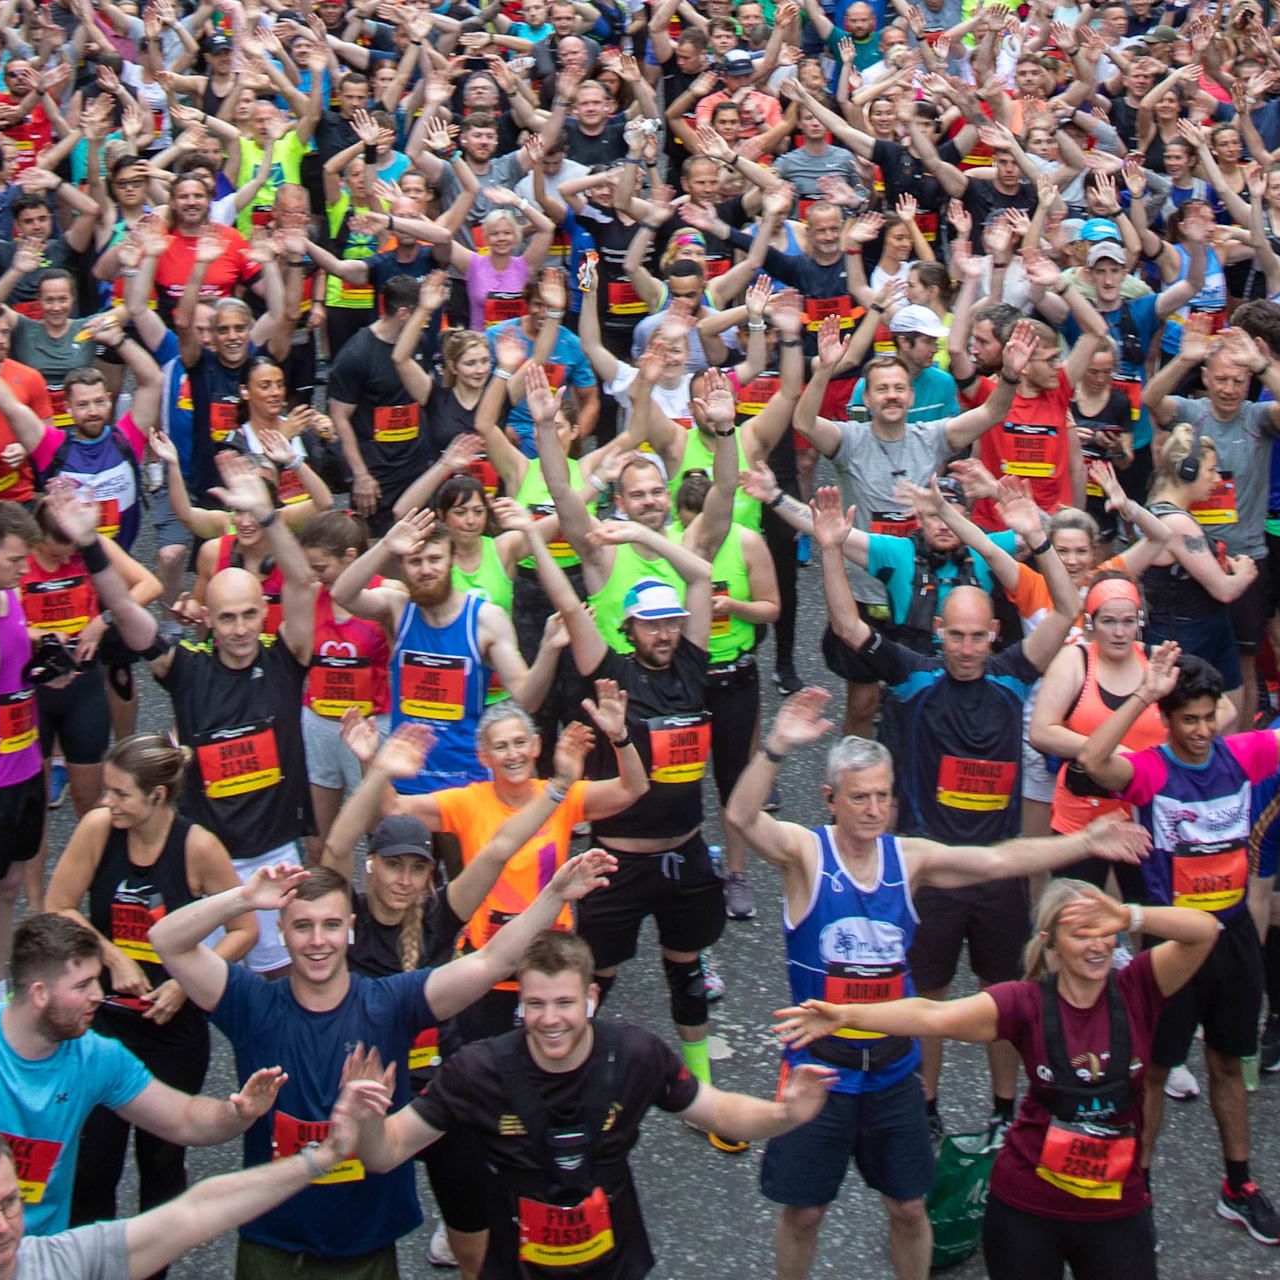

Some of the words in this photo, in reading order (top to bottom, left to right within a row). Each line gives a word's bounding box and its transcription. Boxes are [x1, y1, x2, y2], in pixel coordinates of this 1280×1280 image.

[422, 670, 441, 685] JOE
[219, 739, 254, 761] BRIAN
[956, 759, 1001, 778] THOMAS
[843, 983, 891, 999] ADRIAN
[11, 1139, 35, 1159] ACK
[1069, 1137, 1111, 1160] EMMA
[544, 1208, 586, 1226] FYNN
